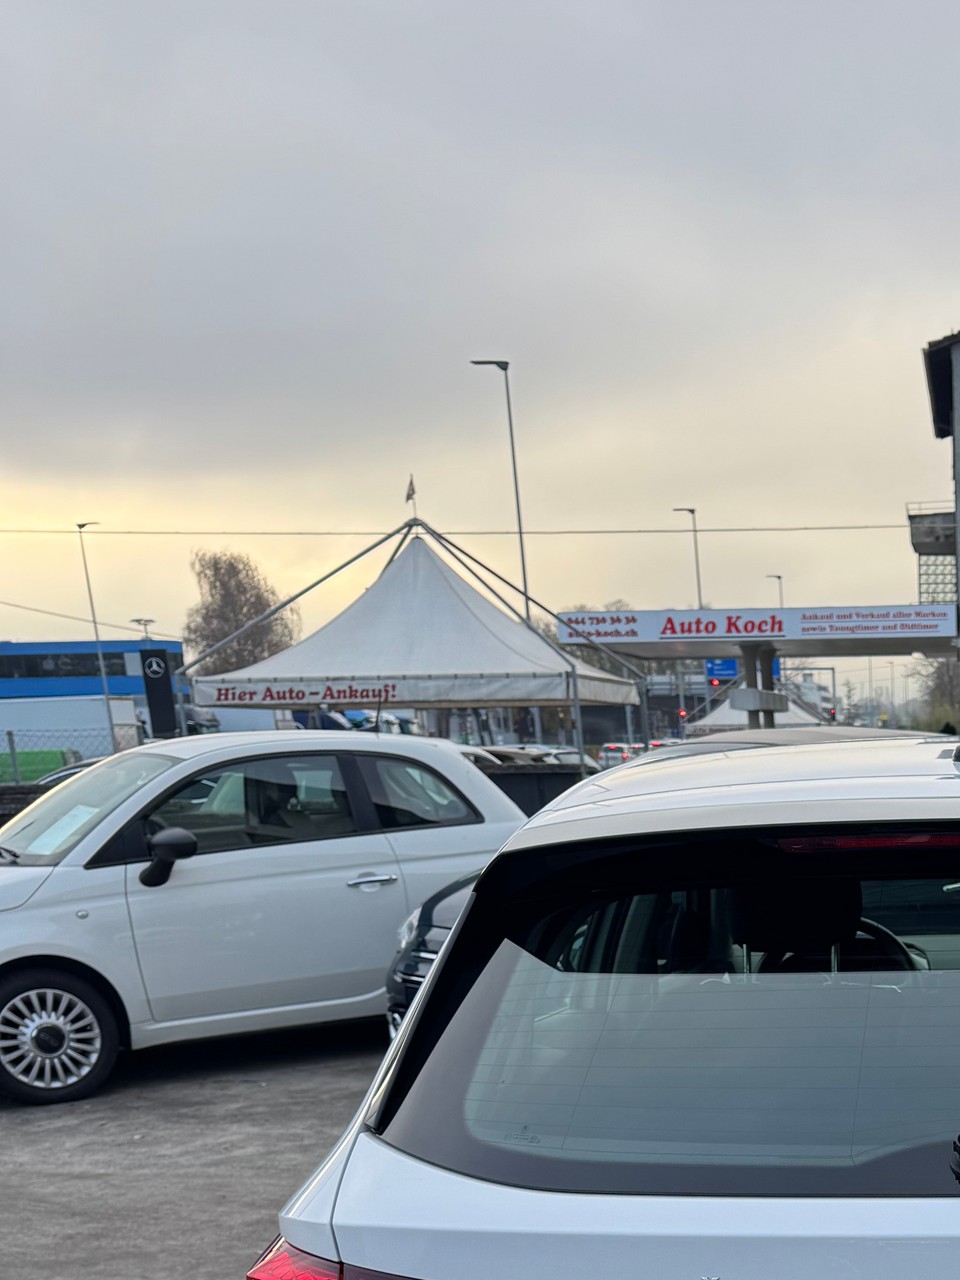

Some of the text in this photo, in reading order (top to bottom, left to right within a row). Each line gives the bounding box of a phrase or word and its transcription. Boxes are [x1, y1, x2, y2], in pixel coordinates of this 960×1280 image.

[660, 614, 784, 635] Auto Koch
[216, 687, 256, 702] Hier
